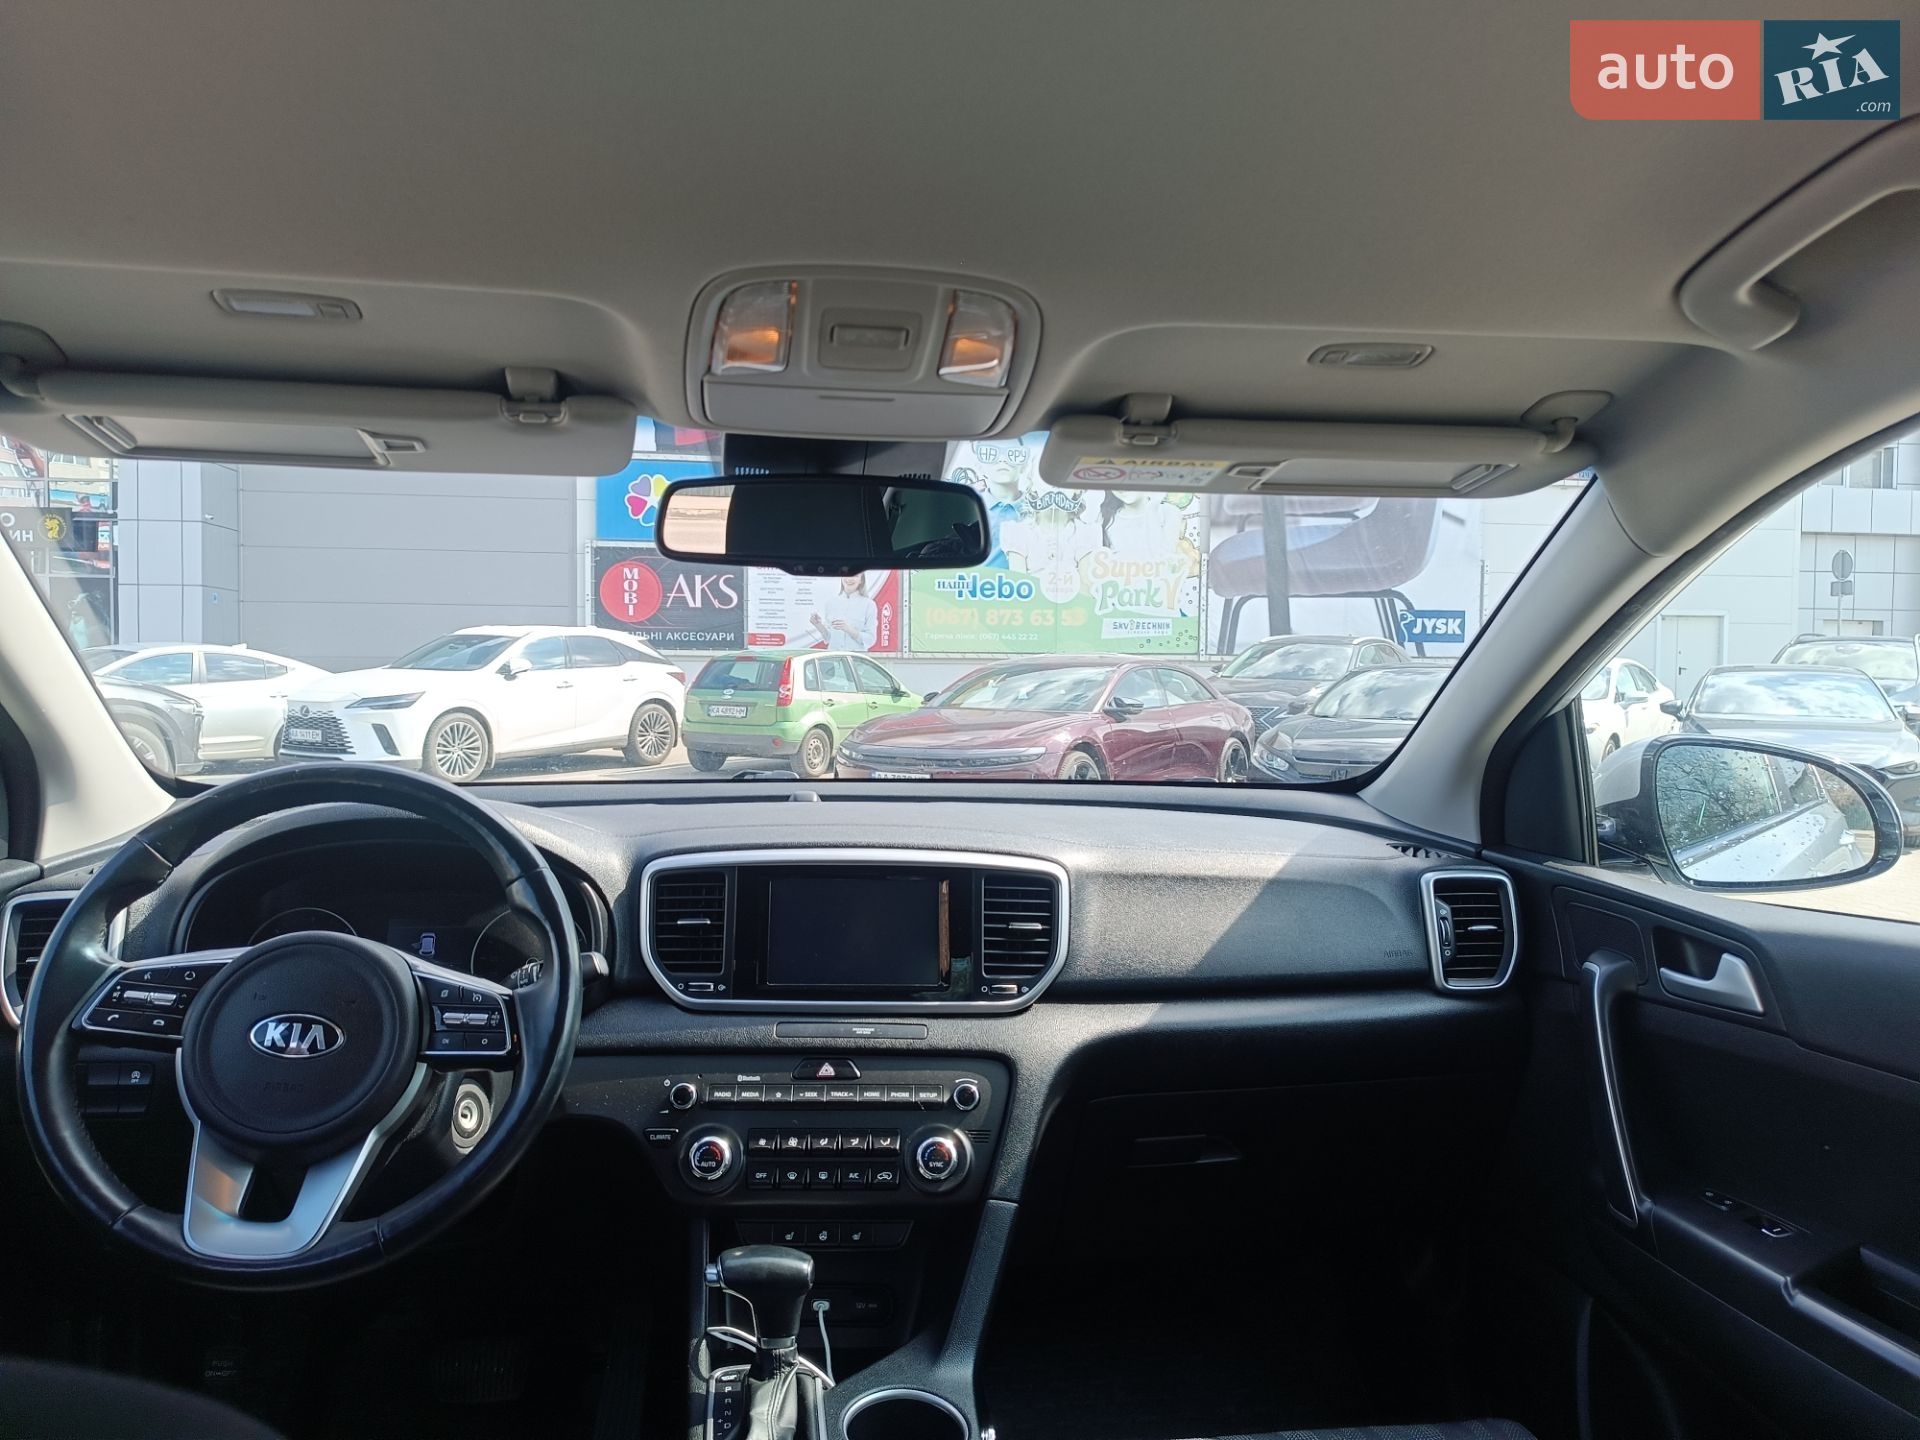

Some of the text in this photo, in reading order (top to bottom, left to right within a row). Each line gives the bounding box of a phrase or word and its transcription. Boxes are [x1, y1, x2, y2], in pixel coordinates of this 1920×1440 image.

[1036, 494, 1074, 511] BIRTHDAY
[1092, 550, 1167, 586] Super
[666, 573, 739, 609] AKS
[958, 574, 1033, 599] Nebo
[1099, 579, 1163, 611] Park
[985, 608, 1024, 627] 873
[1030, 608, 1055, 627] 63
[1412, 617, 1463, 635] JYSK
[666, 631, 735, 641] АКСЕСУАРИ
[263, 1021, 327, 1050] KIA
